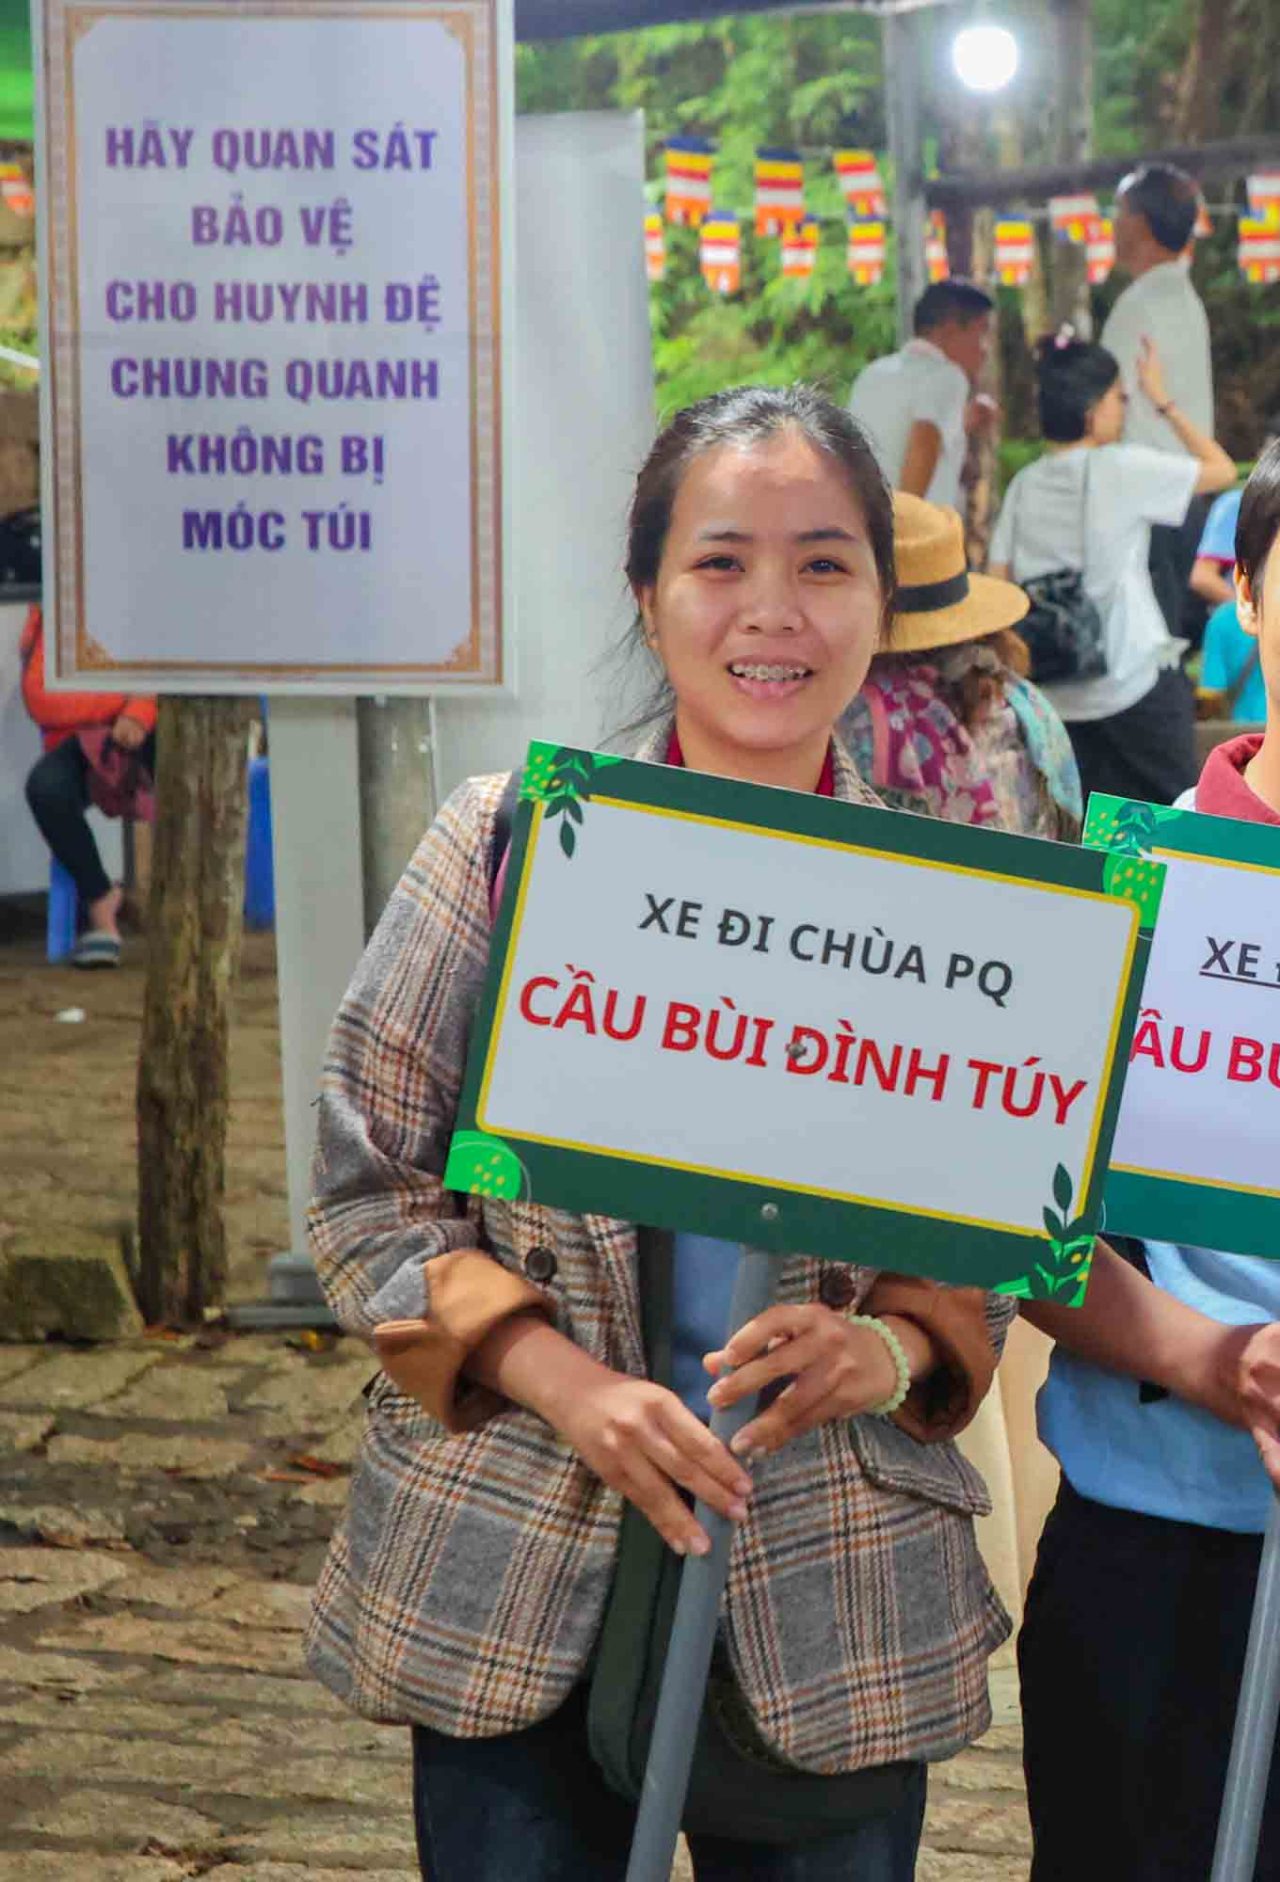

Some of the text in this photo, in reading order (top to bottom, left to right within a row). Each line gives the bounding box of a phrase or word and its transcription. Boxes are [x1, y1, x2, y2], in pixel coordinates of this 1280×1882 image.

[105, 119, 438, 171] HÃY QUAN SÁT
[192, 193, 354, 257] BẢO VỆ
[105, 274, 442, 333] CHO HUYNH ĐỆ
[110, 357, 439, 404] CHUNG QUANH
[165, 425, 386, 486] KHÔNG BỊ
[181, 499, 373, 554] MÓC TÚI
[638, 893, 1016, 1009] XE ĐI CHÙA PQ
[1201, 937, 1262, 979] XE
[518, 964, 1088, 1126] CẦU BÙI ĐÌNH TÚY
